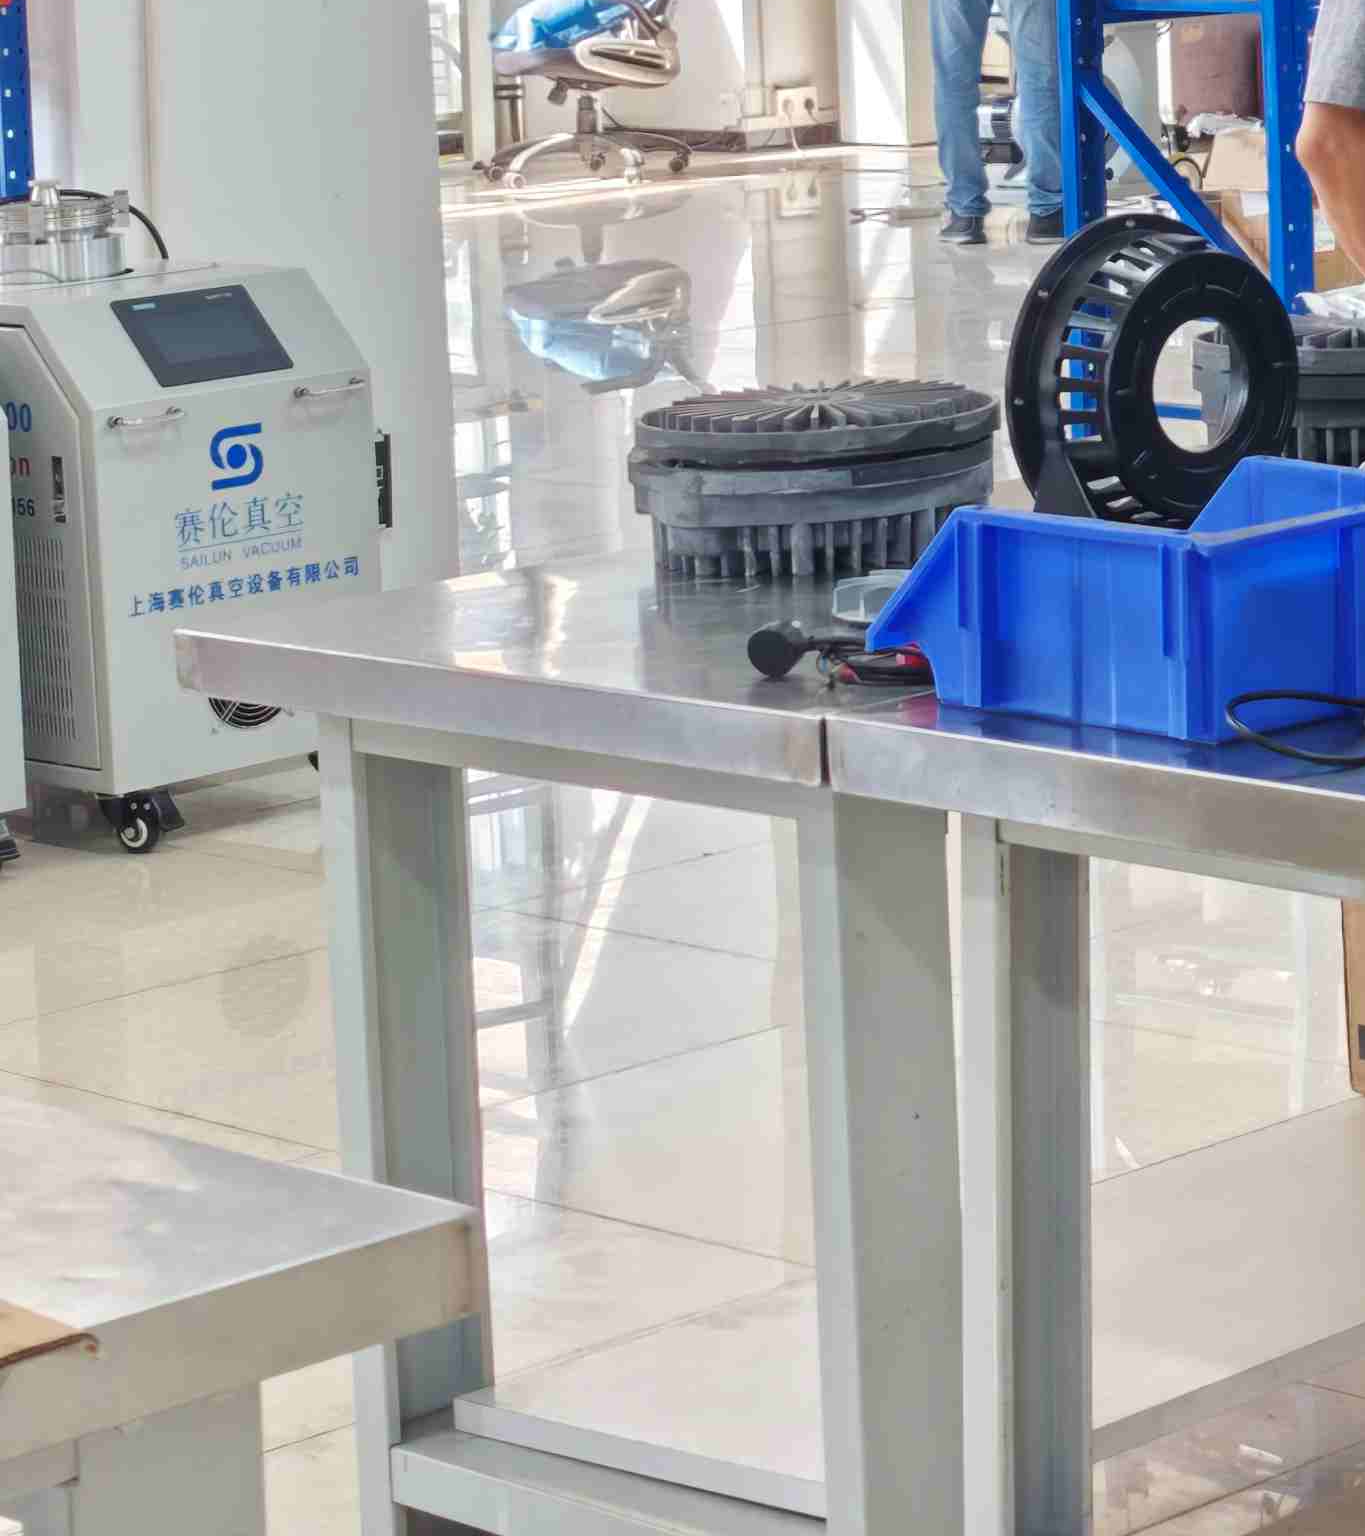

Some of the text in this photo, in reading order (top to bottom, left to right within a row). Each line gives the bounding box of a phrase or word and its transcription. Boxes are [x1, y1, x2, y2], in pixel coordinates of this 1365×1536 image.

[174, 491, 305, 546] 赛伦真空
[180, 537, 303, 571] SAILUN VACUUM
[128, 556, 361, 618] 上海赛伦真空设备有限公司
